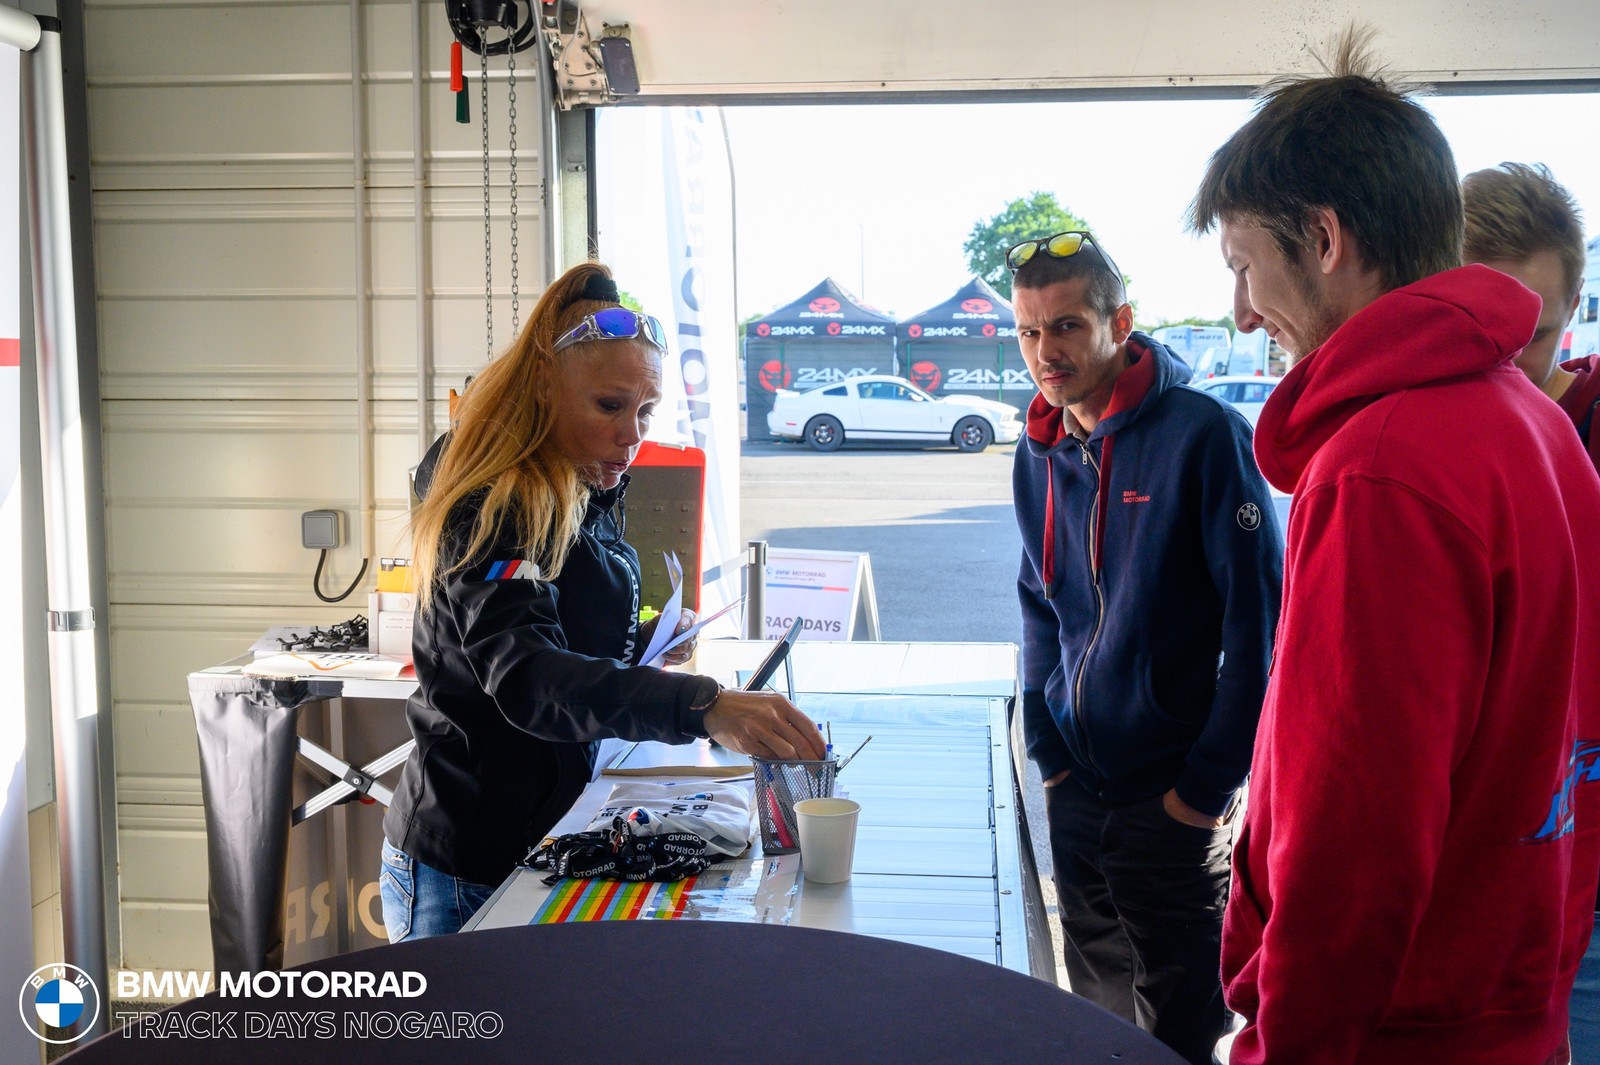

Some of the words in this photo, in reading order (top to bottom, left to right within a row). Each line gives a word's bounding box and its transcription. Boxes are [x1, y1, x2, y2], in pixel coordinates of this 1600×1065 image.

[771, 325, 815, 336] 24MX
[841, 325, 886, 335] 24MX
[924, 326, 967, 337] 24MX
[996, 327, 1018, 338] 24
[947, 368, 1031, 384] 24MX
[765, 616, 794, 629] RAC
[803, 618, 842, 633] DAYS
[663, 843, 706, 856] OTORRAD
[573, 861, 616, 878] OTORRAD
